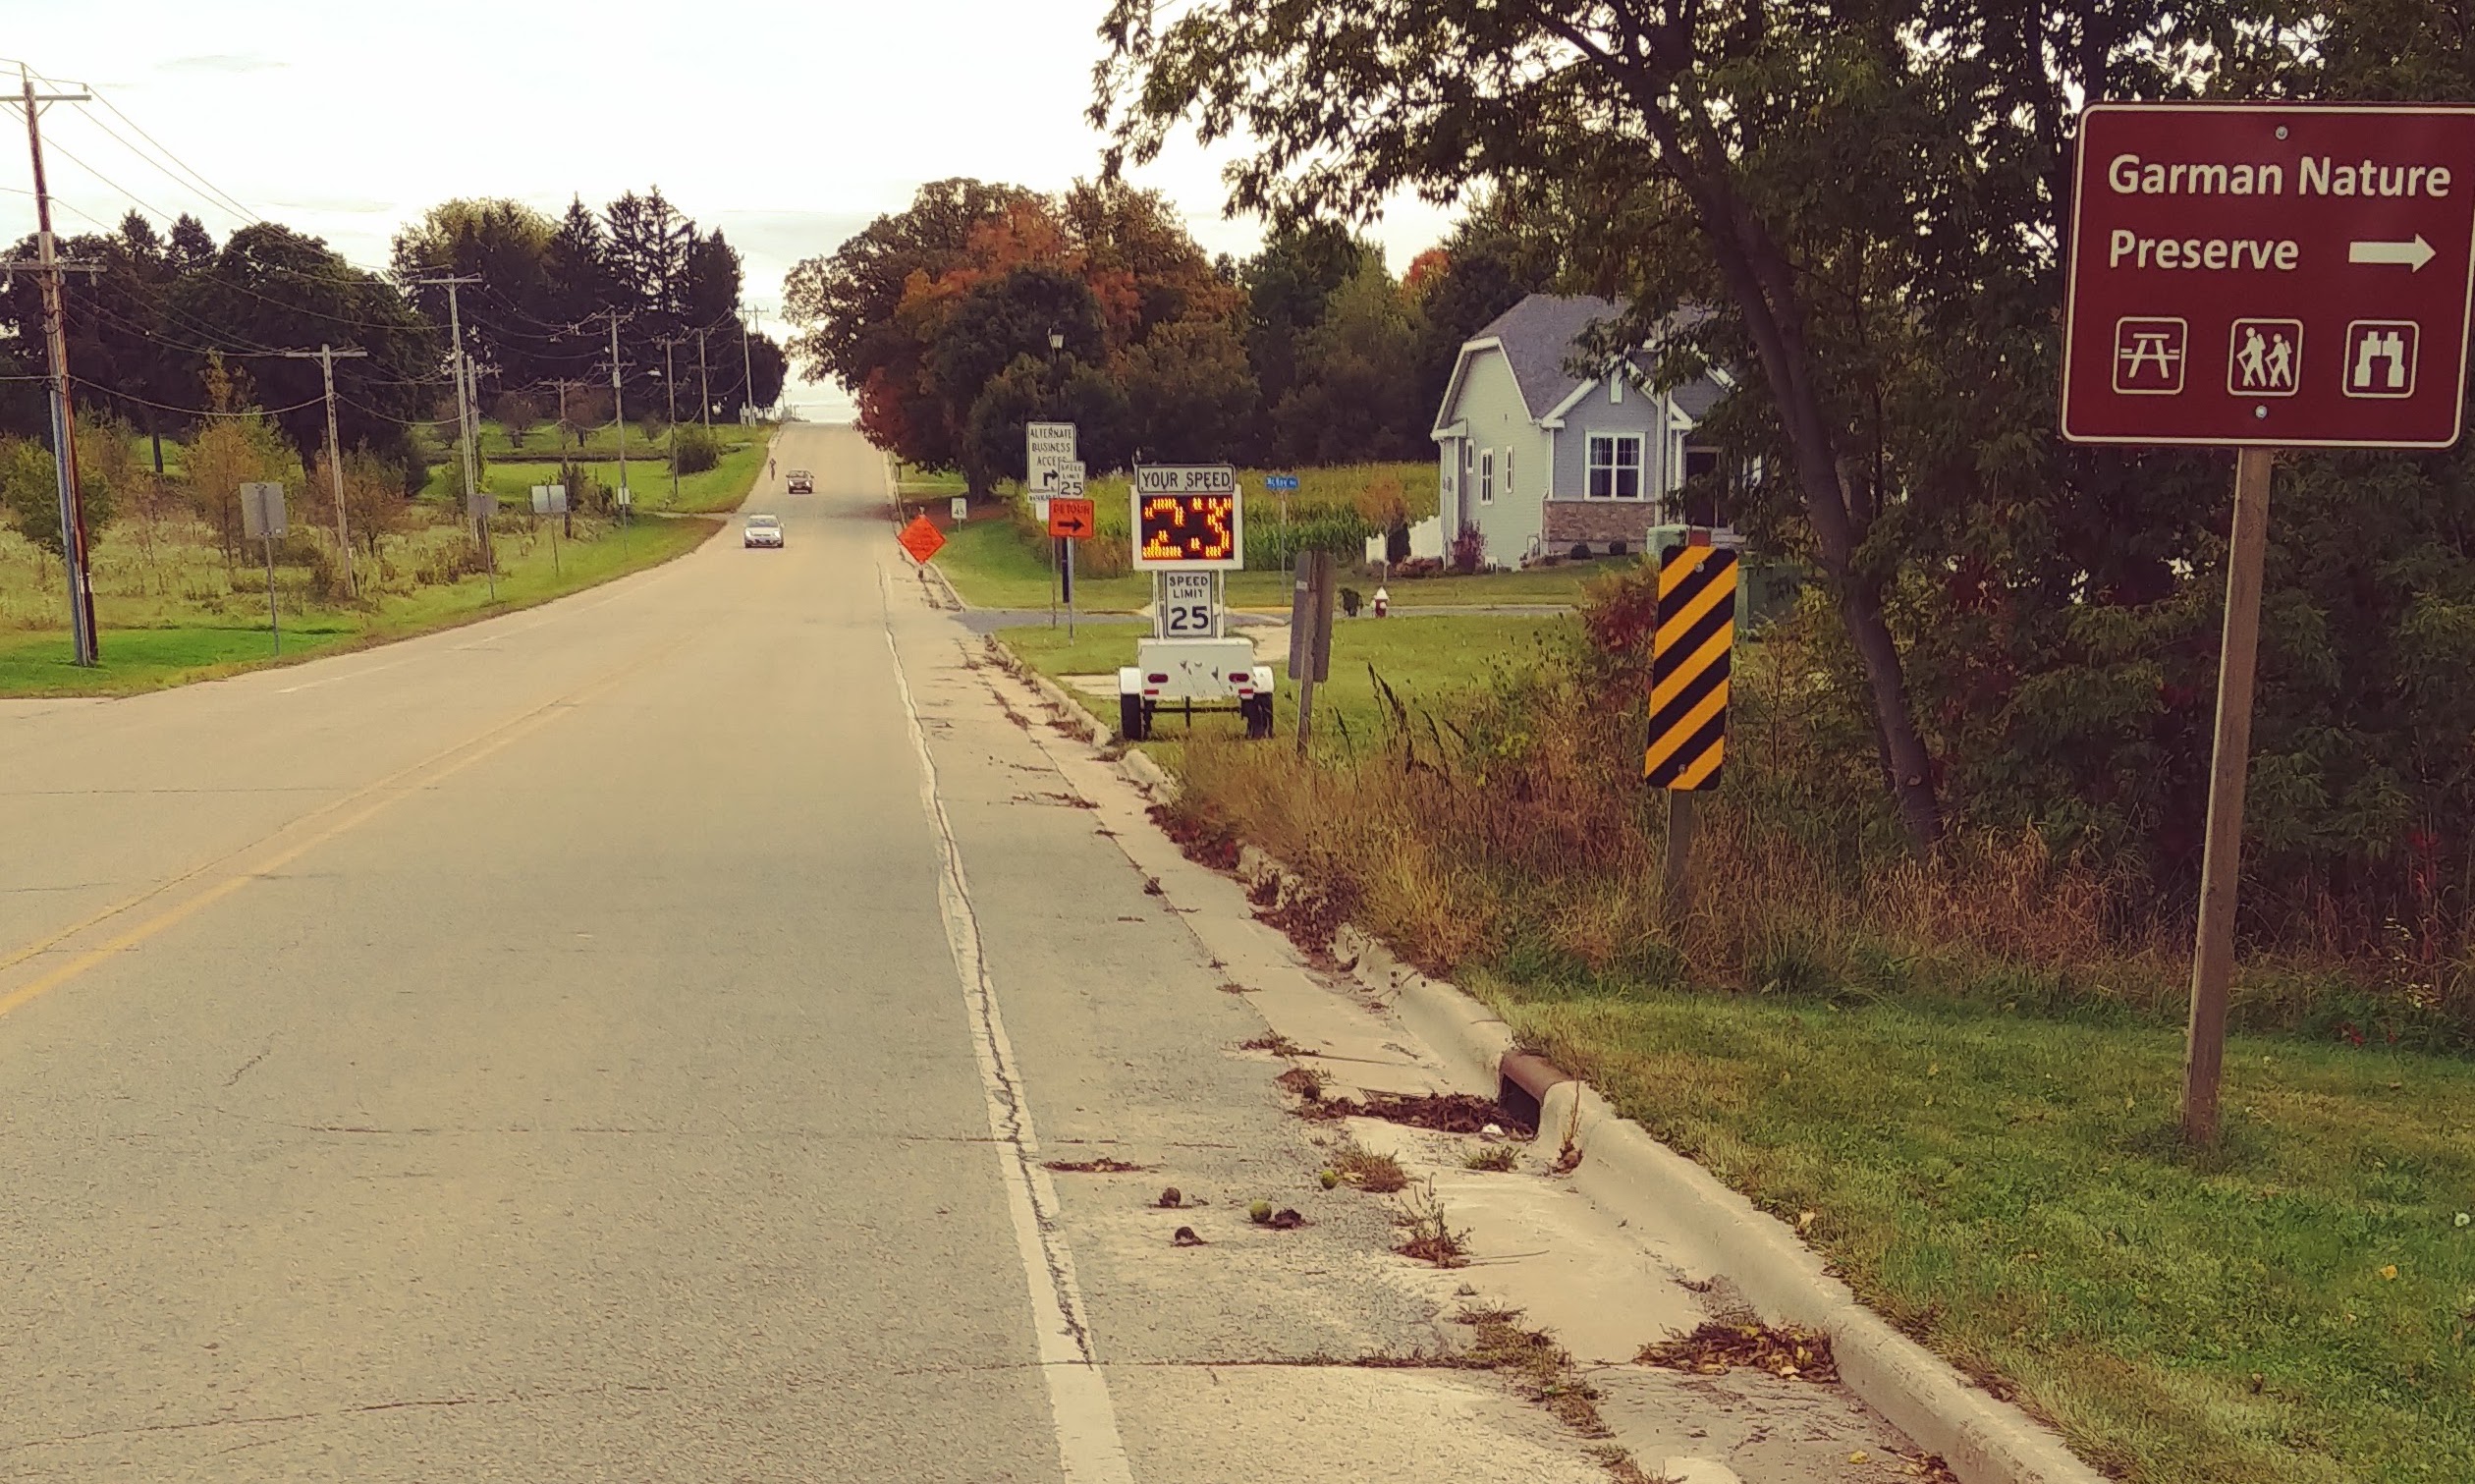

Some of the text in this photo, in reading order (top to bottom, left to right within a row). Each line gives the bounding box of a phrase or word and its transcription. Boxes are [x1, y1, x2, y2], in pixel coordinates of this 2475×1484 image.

[2109, 153, 2451, 196] Garman Nature
[2110, 229, 2299, 270] Preserve
[1030, 427, 1072, 439] ALTERNATE
[1031, 442, 1071, 453] BUSINESS
[1141, 471, 1231, 488] YOUR SPEED
[1061, 481, 1083, 496] 25
[1053, 503, 1090, 516] DETOUR
[1169, 576, 1208, 587] SPEED
[1173, 588, 1203, 599] LIMIT
[1171, 605, 1209, 630] 25
